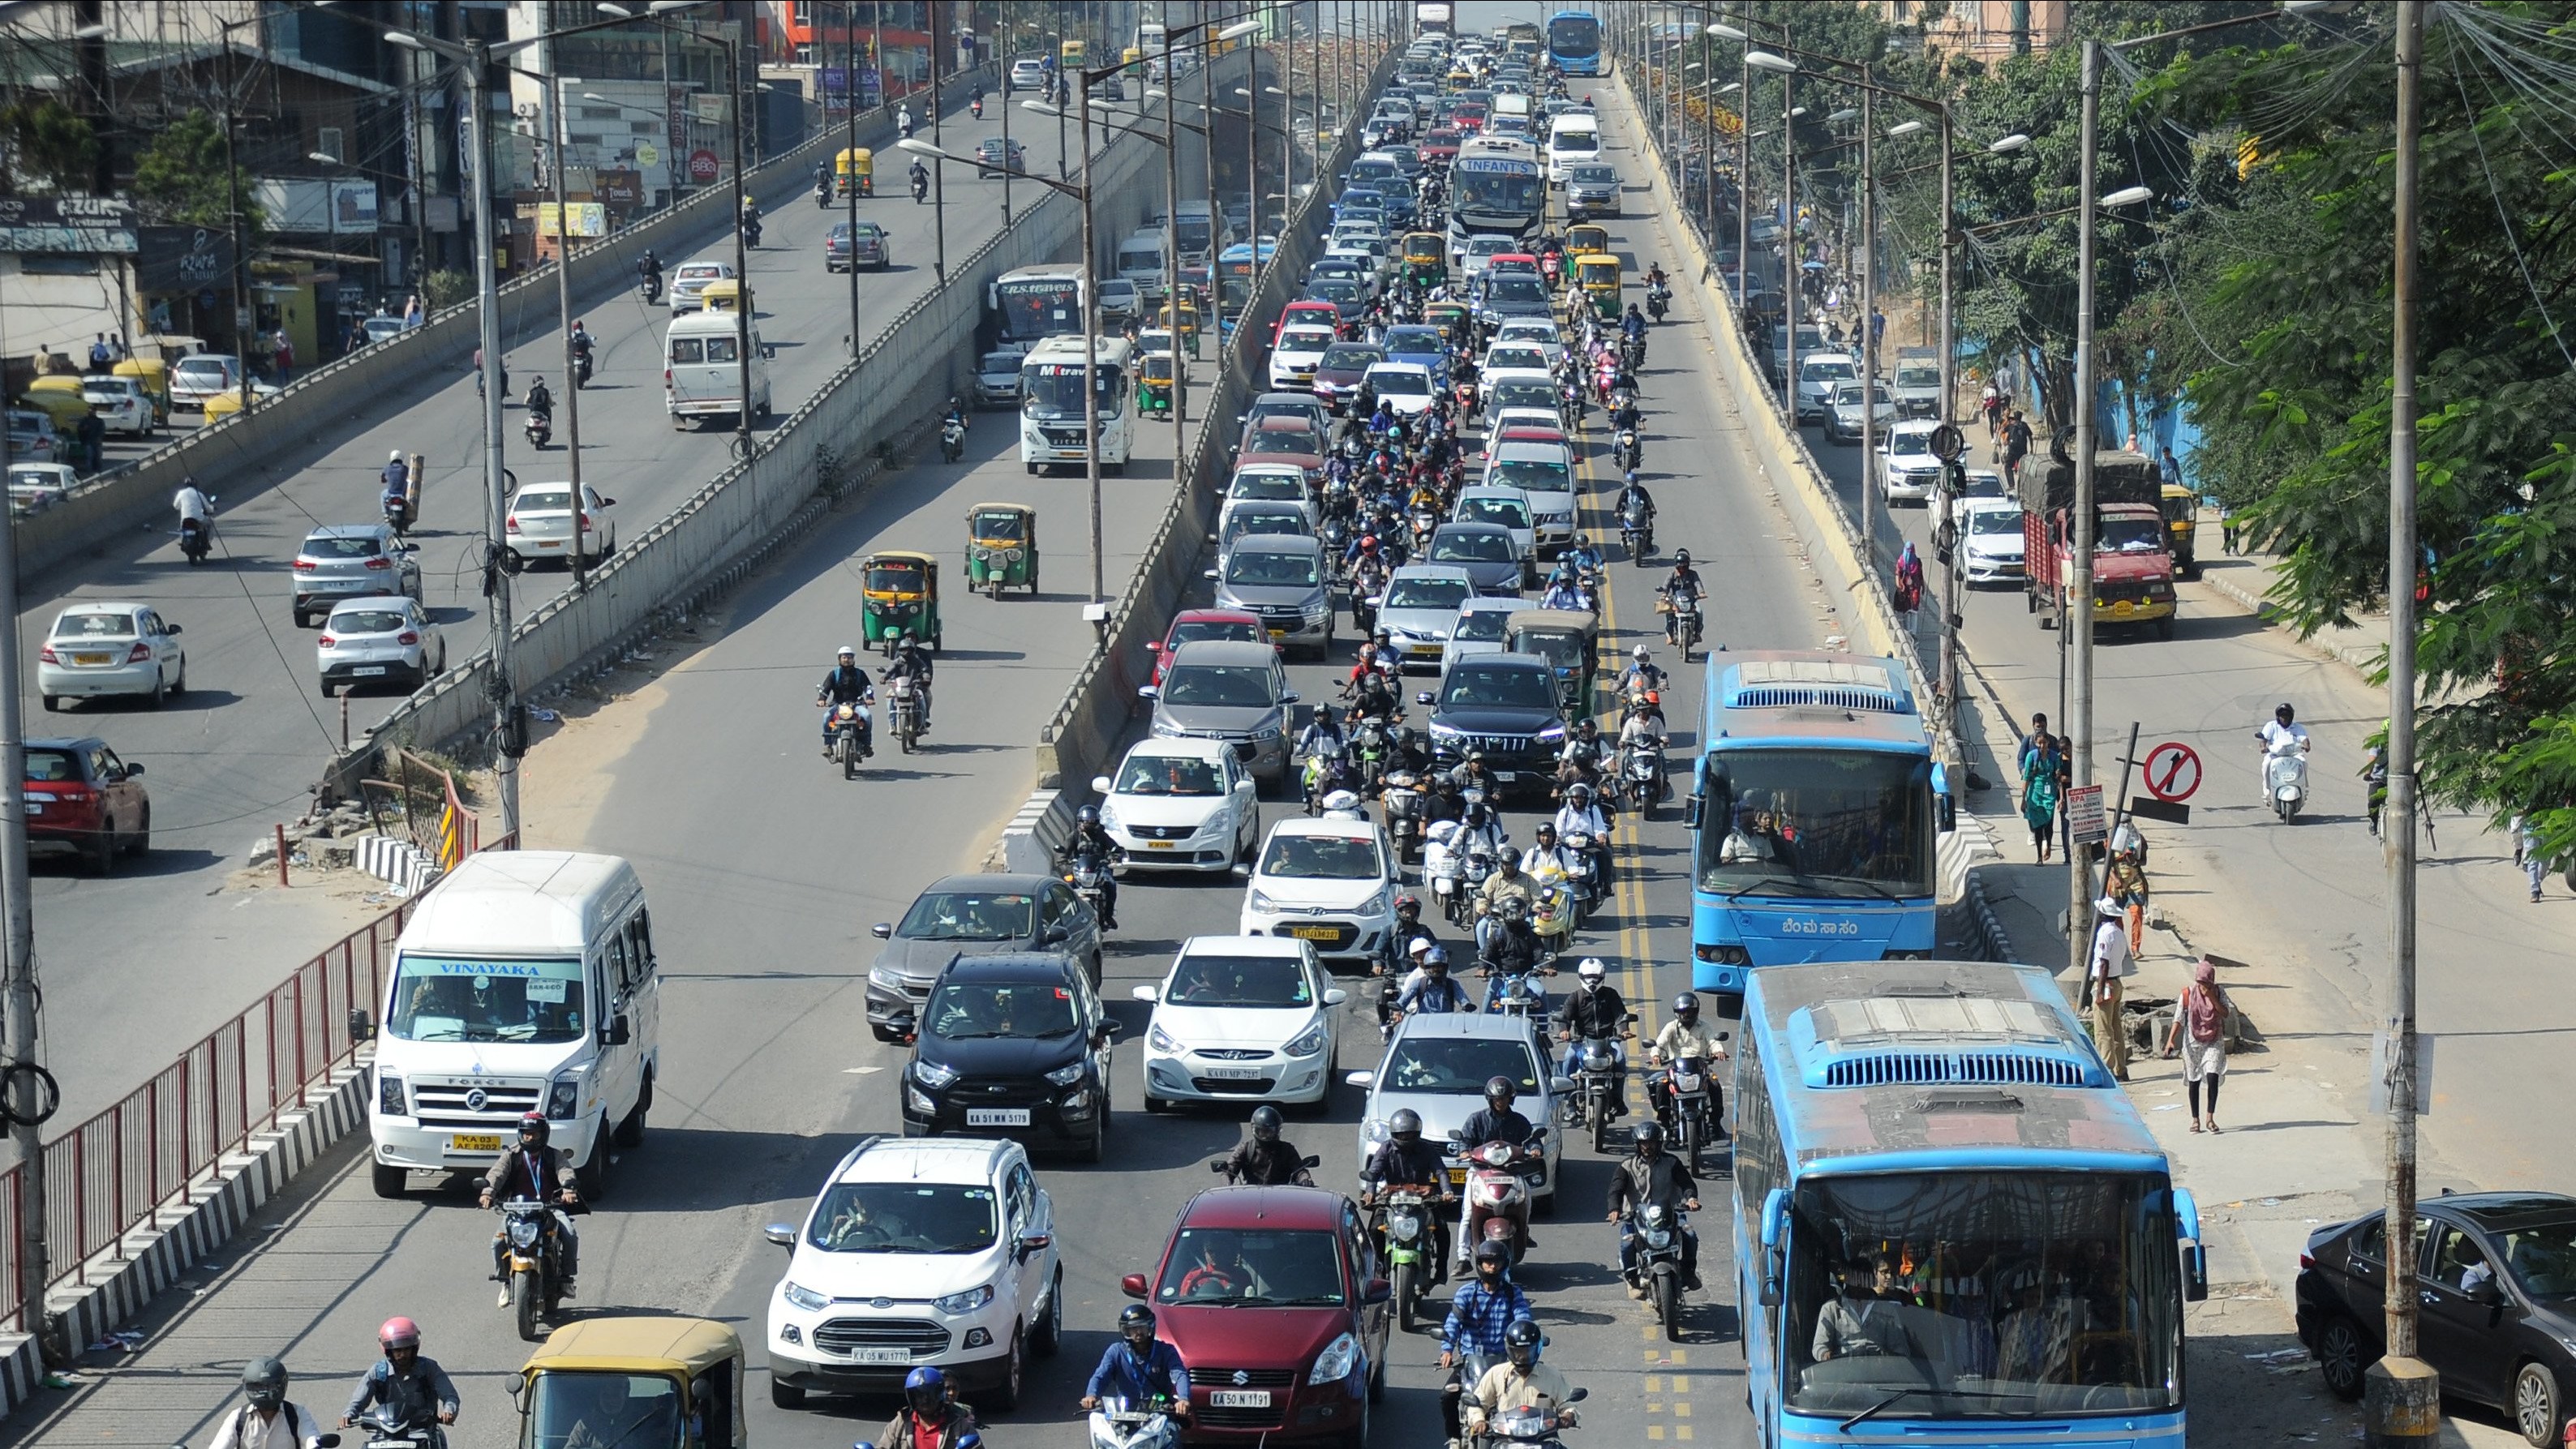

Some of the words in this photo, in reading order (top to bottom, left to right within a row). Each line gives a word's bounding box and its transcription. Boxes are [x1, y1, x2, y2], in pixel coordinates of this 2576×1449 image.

[1466, 161, 1528, 173] INFANT'S
[441, 963, 541, 976] VINAYAKA
[969, 1114, 981, 1123] KA
[982, 1114, 992, 1123] 51
[462, 1135, 477, 1143] KA
[853, 1352, 865, 1361] KA
[866, 1352, 876, 1361] 05
[878, 1352, 889, 1361] MU
[890, 1352, 908, 1361] 1770
[1213, 1393, 1225, 1405] KA
[1226, 1394, 1237, 1404] 50
[1239, 1394, 1246, 1405] N
[1249, 1394, 1268, 1406] 1191
